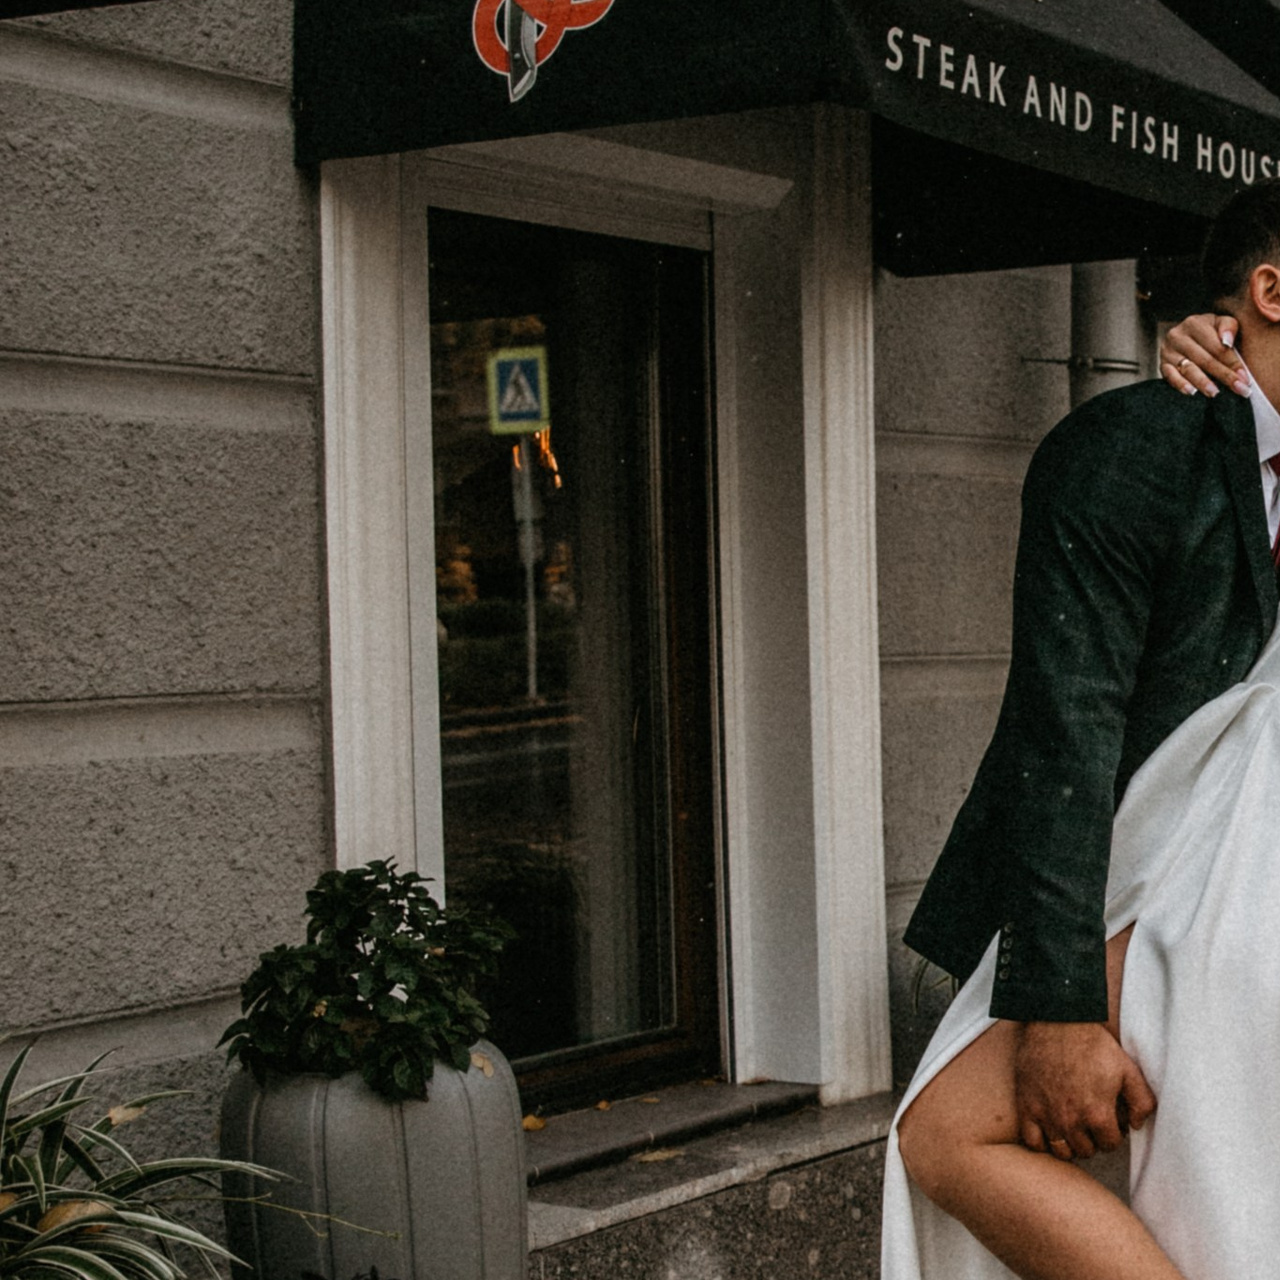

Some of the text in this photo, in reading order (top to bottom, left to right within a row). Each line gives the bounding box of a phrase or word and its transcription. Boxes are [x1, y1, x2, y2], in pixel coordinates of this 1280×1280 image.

[885, 26, 1006, 108] STEAK
[1022, 75, 1093, 131] AND
[1111, 104, 1179, 162] FISH
